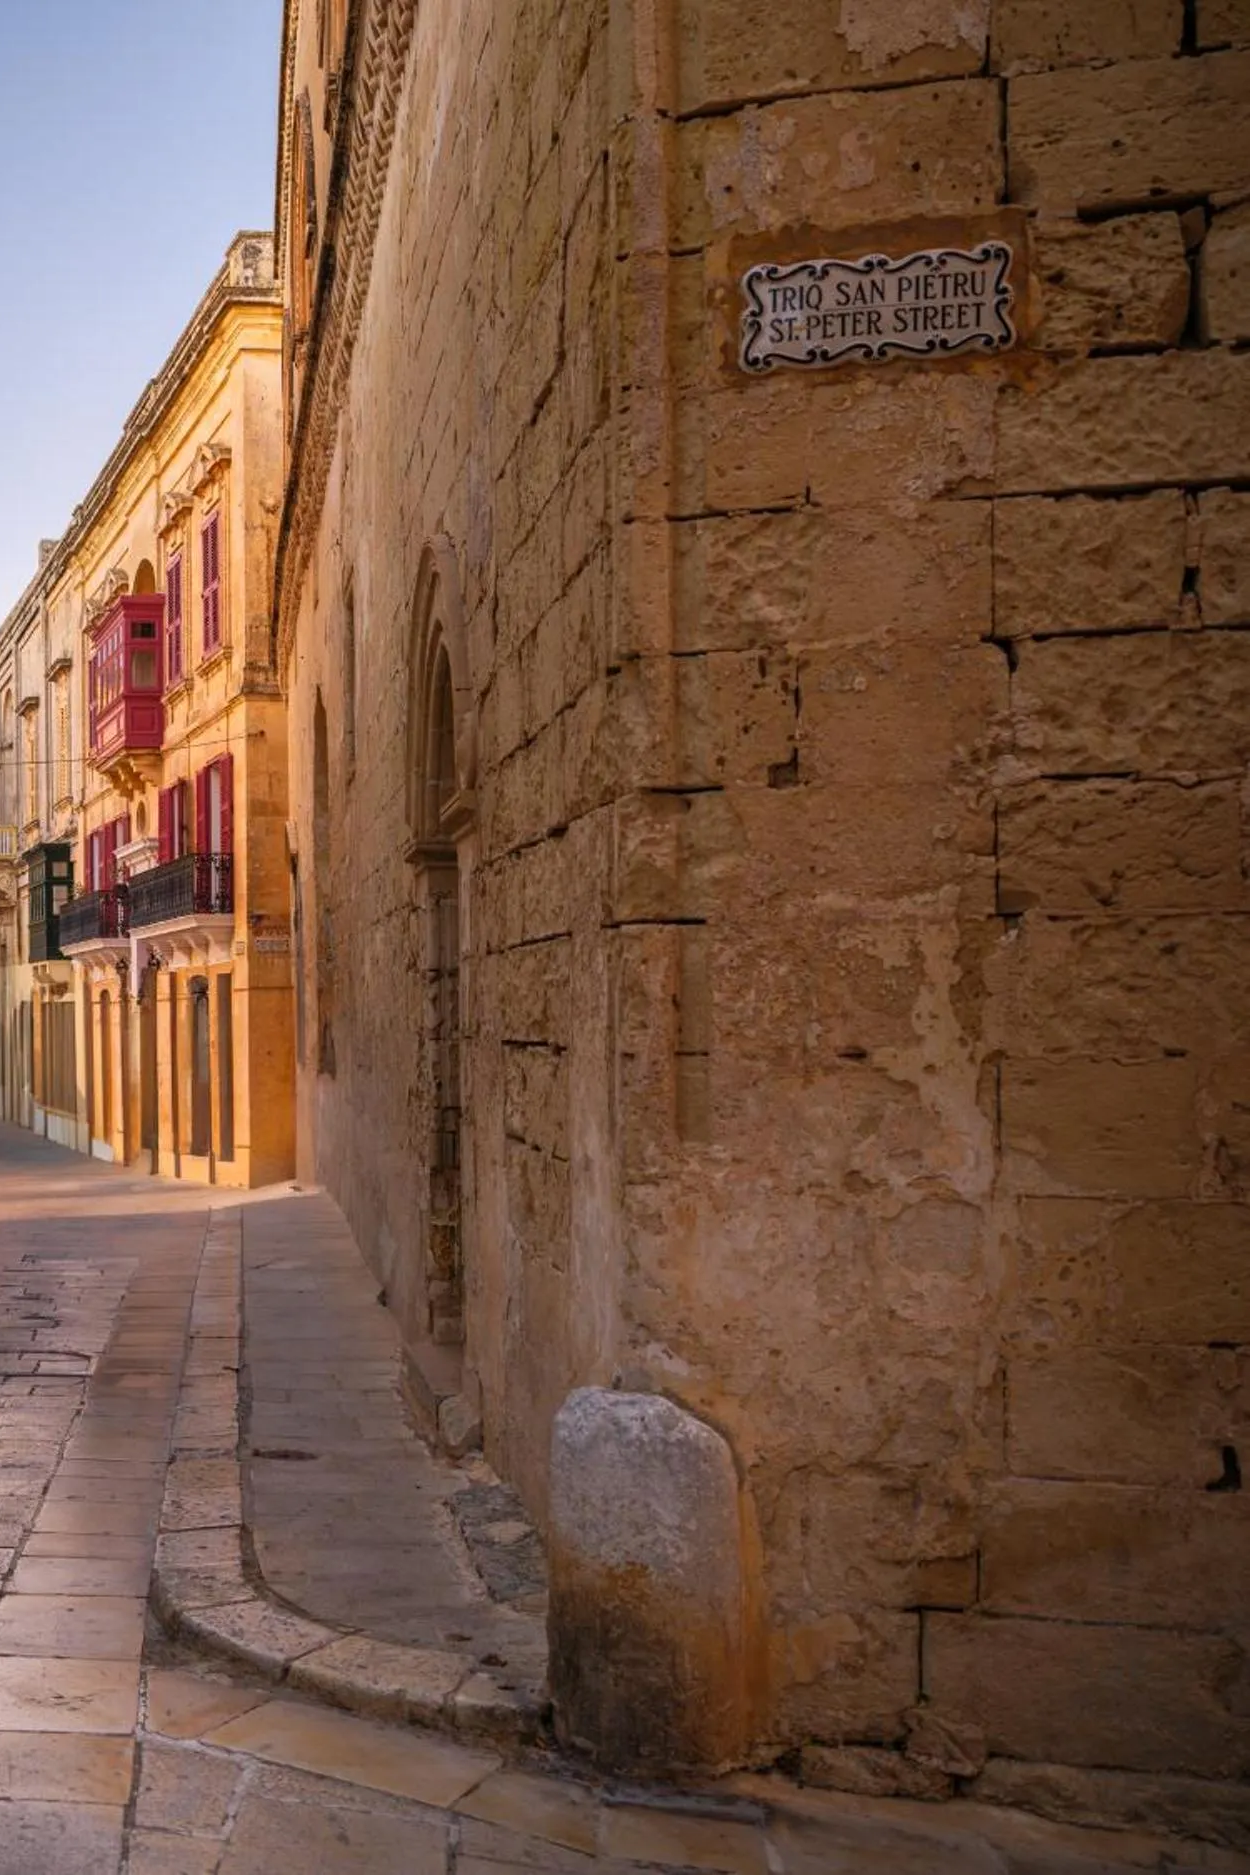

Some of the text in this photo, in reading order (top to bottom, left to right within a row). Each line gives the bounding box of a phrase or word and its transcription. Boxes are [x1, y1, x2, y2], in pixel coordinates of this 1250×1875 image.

[768, 270, 986, 313] TRIQ SAN PIETRU
[806, 310, 883, 340] PETER
[893, 302, 986, 333] STREET
